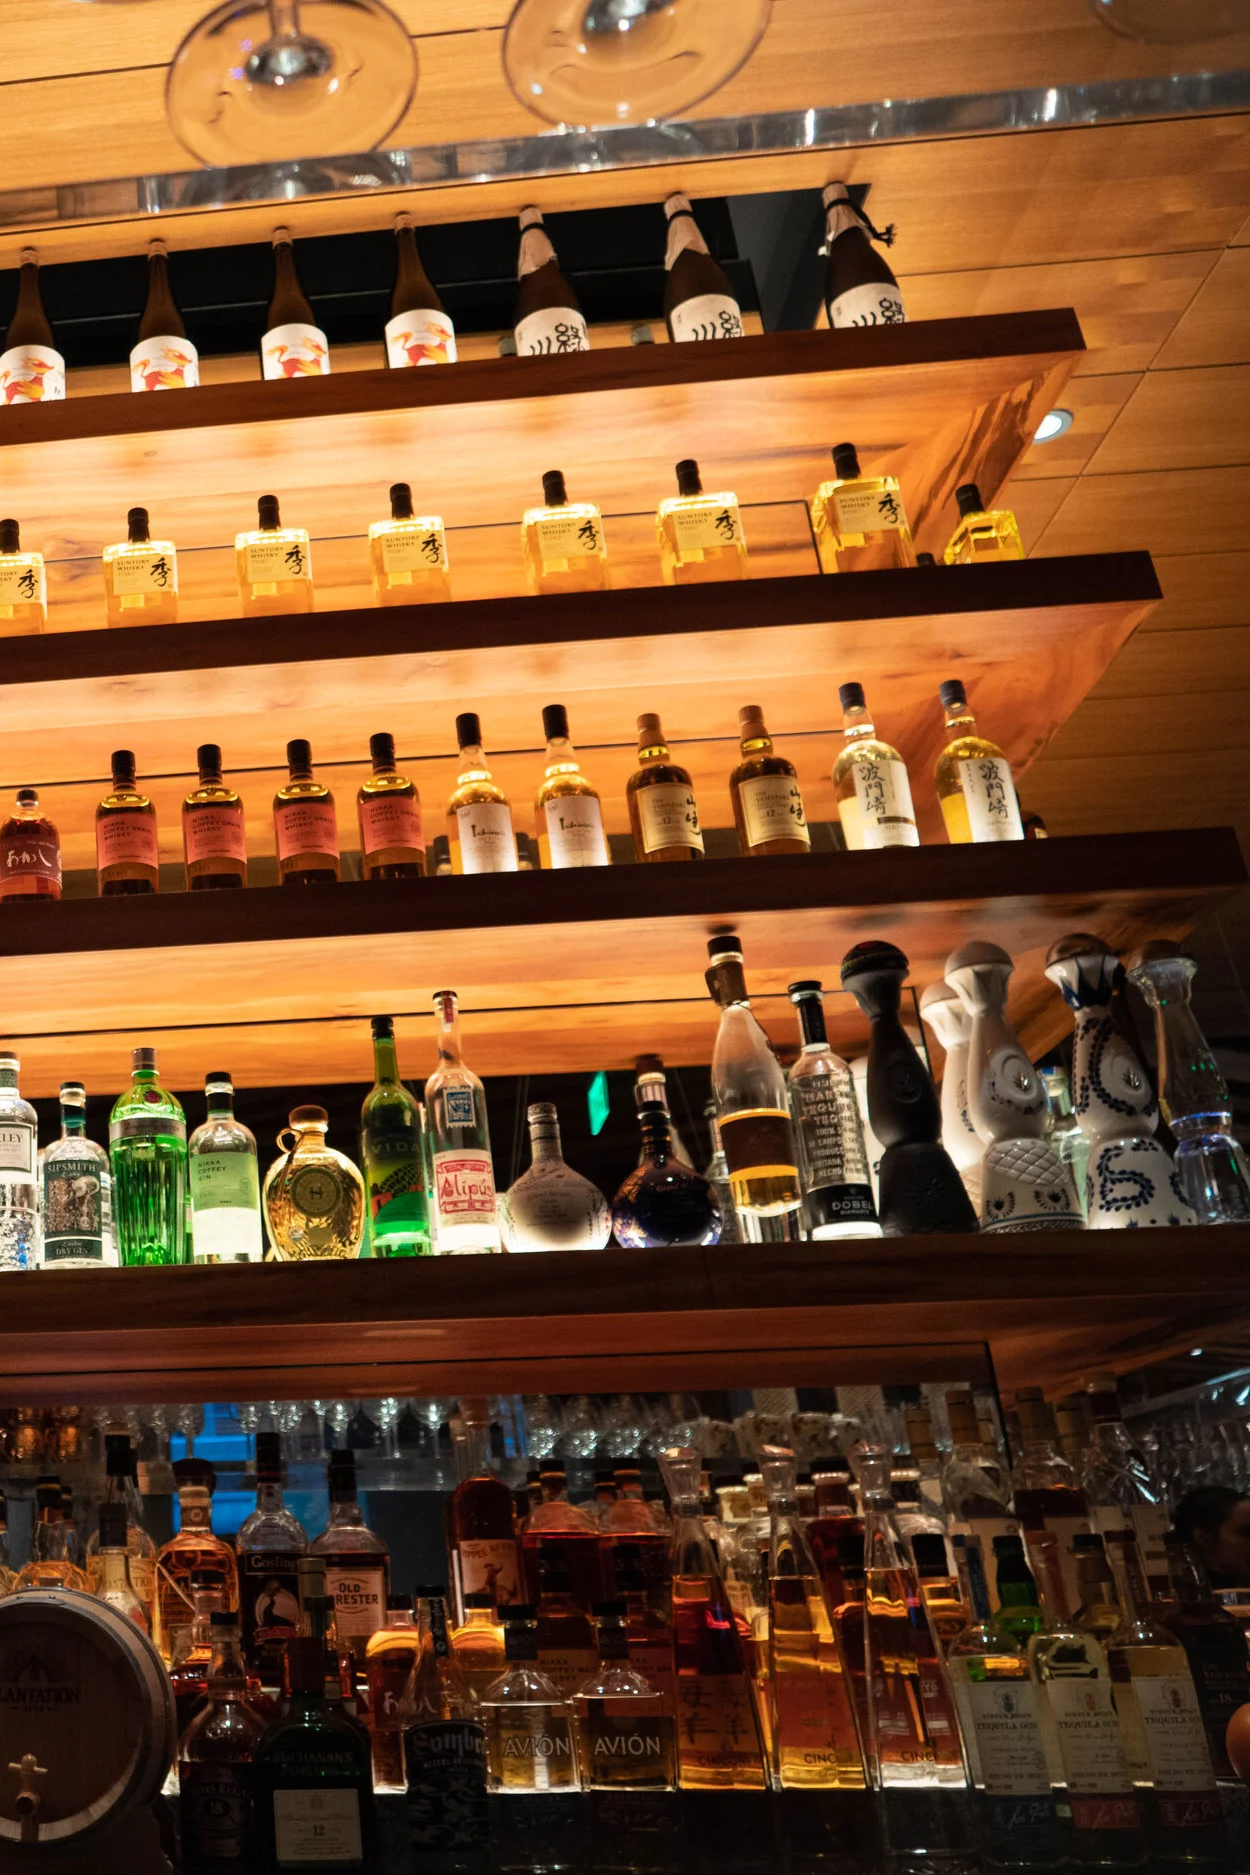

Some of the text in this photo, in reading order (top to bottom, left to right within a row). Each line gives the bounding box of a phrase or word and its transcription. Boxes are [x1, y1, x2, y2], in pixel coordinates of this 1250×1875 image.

[839, 496, 876, 504] SUNTORY
[840, 502, 871, 510] WHISKY
[879, 493, 900, 524] 季
[678, 512, 712, 520] SUNTORY
[542, 522, 576, 530] SUNTORY
[715, 509, 738, 540] 季
[578, 520, 600, 551] 季
[421, 533, 443, 564] 季
[285, 545, 306, 575] 季
[150, 557, 172, 587] 季
[18, 569, 39, 598] 季
[859, 762, 886, 815] 波門崎
[371, 804, 393, 813] NIKKA
[284, 810, 307, 819] NIKKA
[371, 809, 399, 819] COFFEY
[104, 820, 125, 829] NIKKA
[192, 815, 216, 824] NIKKA
[285, 817, 312, 826] COFFEY
[371, 816, 400, 825] WHISKY
[192, 821, 222, 830] COFFEY
[193, 826, 221, 835] WHISKY
[286, 822, 314, 831] WHISKY
[103, 826, 130, 836] COFFEY
[105, 831, 131, 841] WHISKY
[371, 1141, 424, 1155] VIDA
[47, 1163, 97, 1173] SIPSMITH
[198, 1167, 227, 1175] COFFEY
[439, 1174, 494, 1204] Alipús
[55, 1246, 89, 1256] DRY GIN
[338, 1582, 361, 1593] OLD
[334, 1594, 379, 1606] RESTER
[1058, 1720, 1101, 1729] TEQUILA
[1145, 1716, 1187, 1725] TEQUILA
[976, 1722, 1018, 1732] TEQUILA
[503, 1733, 570, 1758] AVIÓN
[594, 1733, 662, 1757] AVIÓN
[312, 1824, 325, 1836] 12
